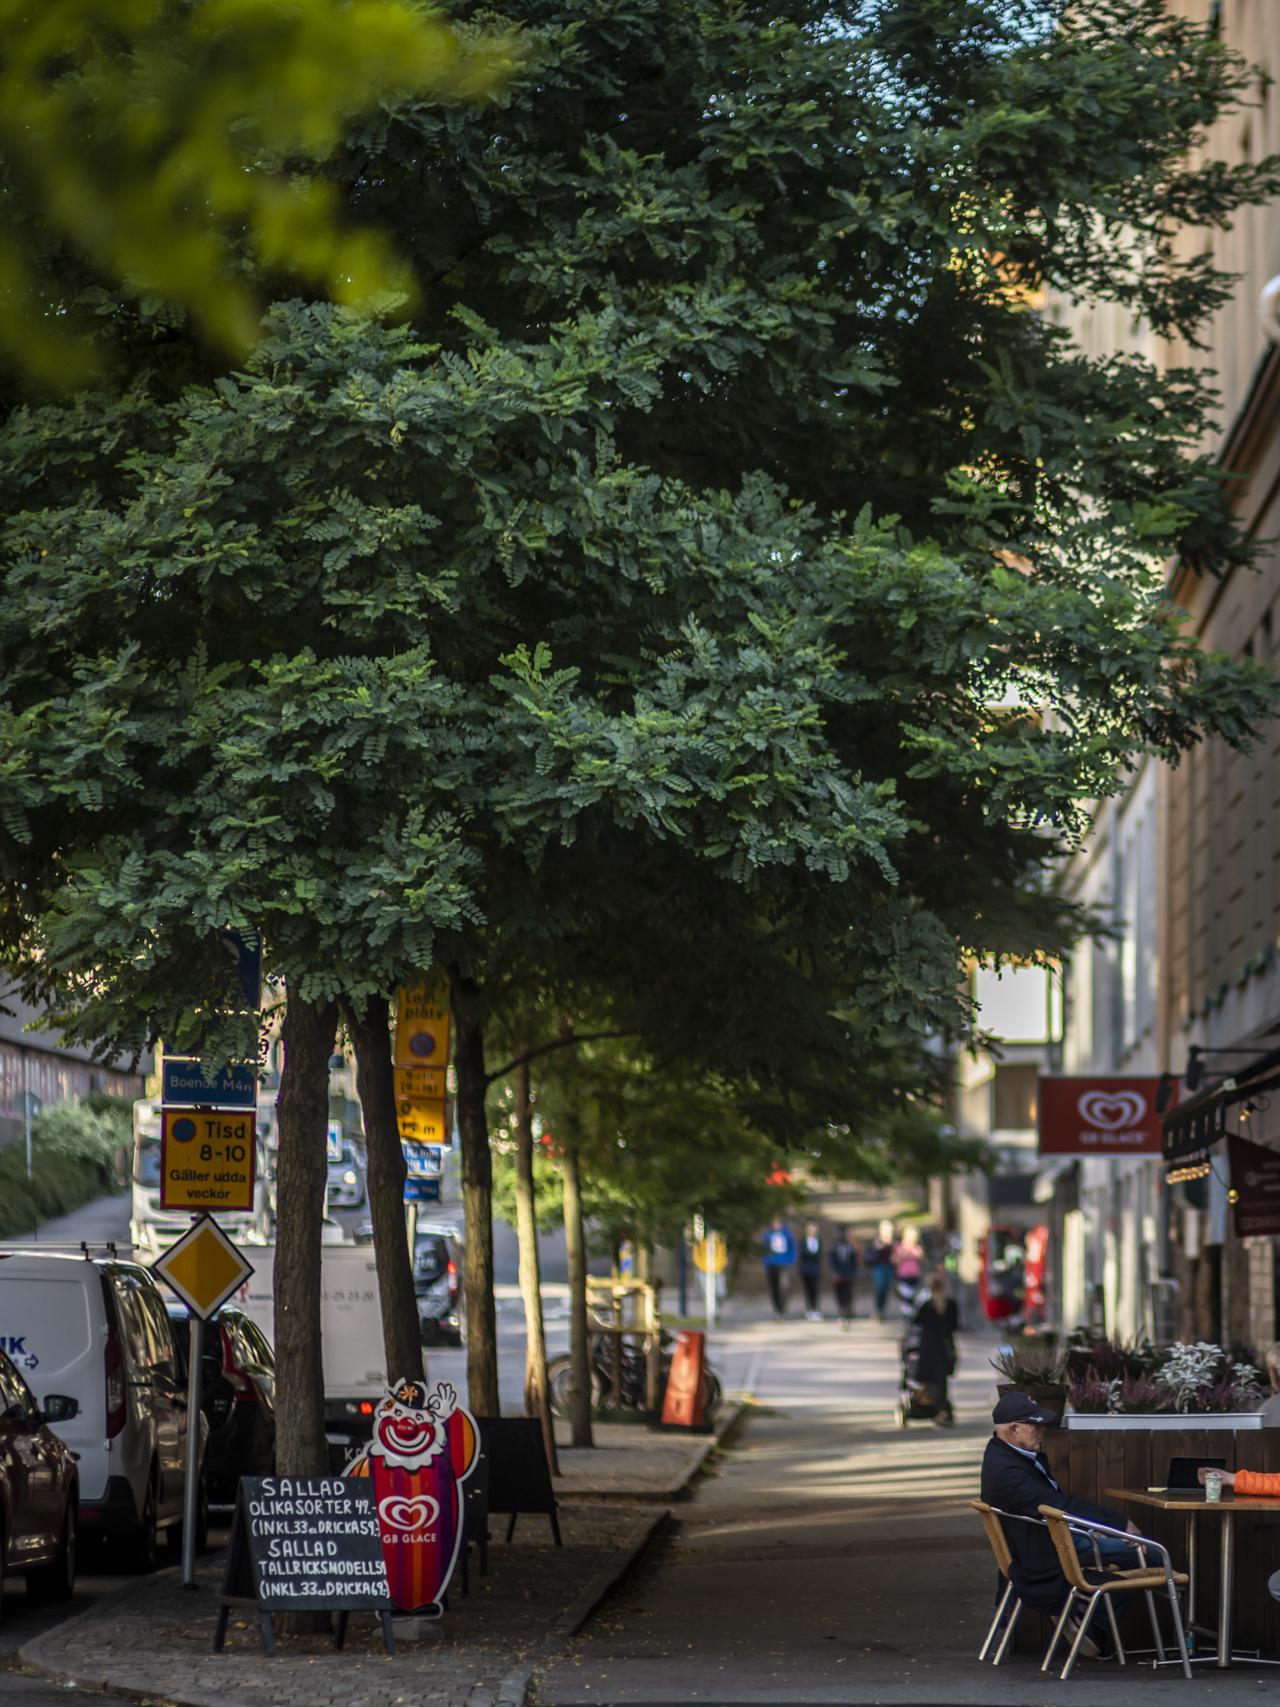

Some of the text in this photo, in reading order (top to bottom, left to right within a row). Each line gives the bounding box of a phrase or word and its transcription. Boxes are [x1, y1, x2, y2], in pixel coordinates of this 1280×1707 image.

[170, 1075, 218, 1090] Boende
[205, 1121, 246, 1139] Tisd
[200, 1144, 246, 1162] 8-10
[170, 1169, 247, 1183] Gäller udda
[187, 1186, 231, 1200] veckor
[261, 1478, 345, 1497] SALLAD
[382, 1532, 437, 1545] GB GLACE
[268, 1539, 338, 1558] SALLAD
